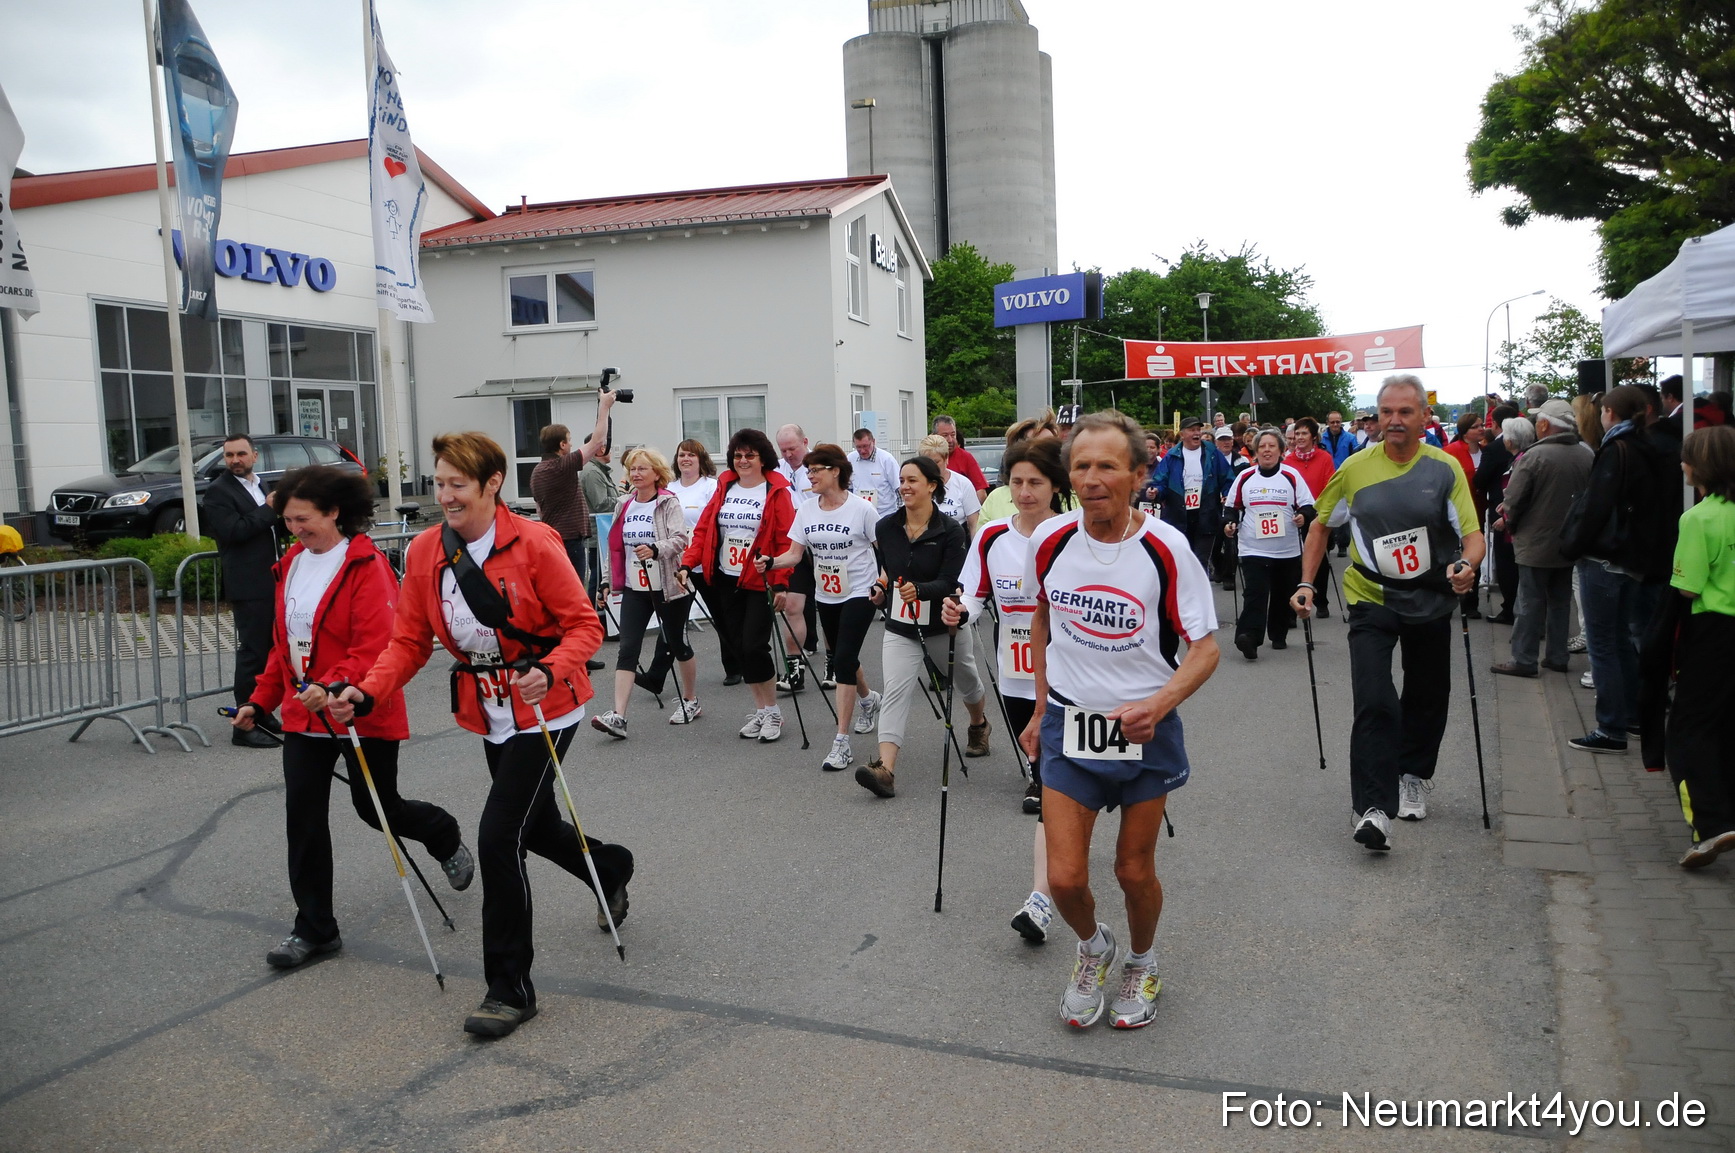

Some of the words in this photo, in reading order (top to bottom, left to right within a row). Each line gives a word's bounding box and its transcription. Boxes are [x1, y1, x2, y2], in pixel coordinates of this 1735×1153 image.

[870, 233, 898, 273] Bauer
[1001, 288, 1070, 311] VOLVO
[1185, 494, 1199, 507] 42
[737, 512, 762, 521] GIRLS
[1261, 518, 1279, 535] 95
[804, 523, 851, 536] BERGER
[1382, 533, 1408, 546] MEYER
[829, 540, 853, 551] GIRLS
[729, 546, 748, 566] 34
[1391, 544, 1420, 575] 13
[821, 573, 842, 594] 23
[1050, 589, 1128, 616] GERHART
[1082, 610, 1137, 630] JÄNIG
[1060, 622, 1072, 636] Das
[1072, 634, 1110, 652] sportliche
[1074, 711, 1130, 754] 104
